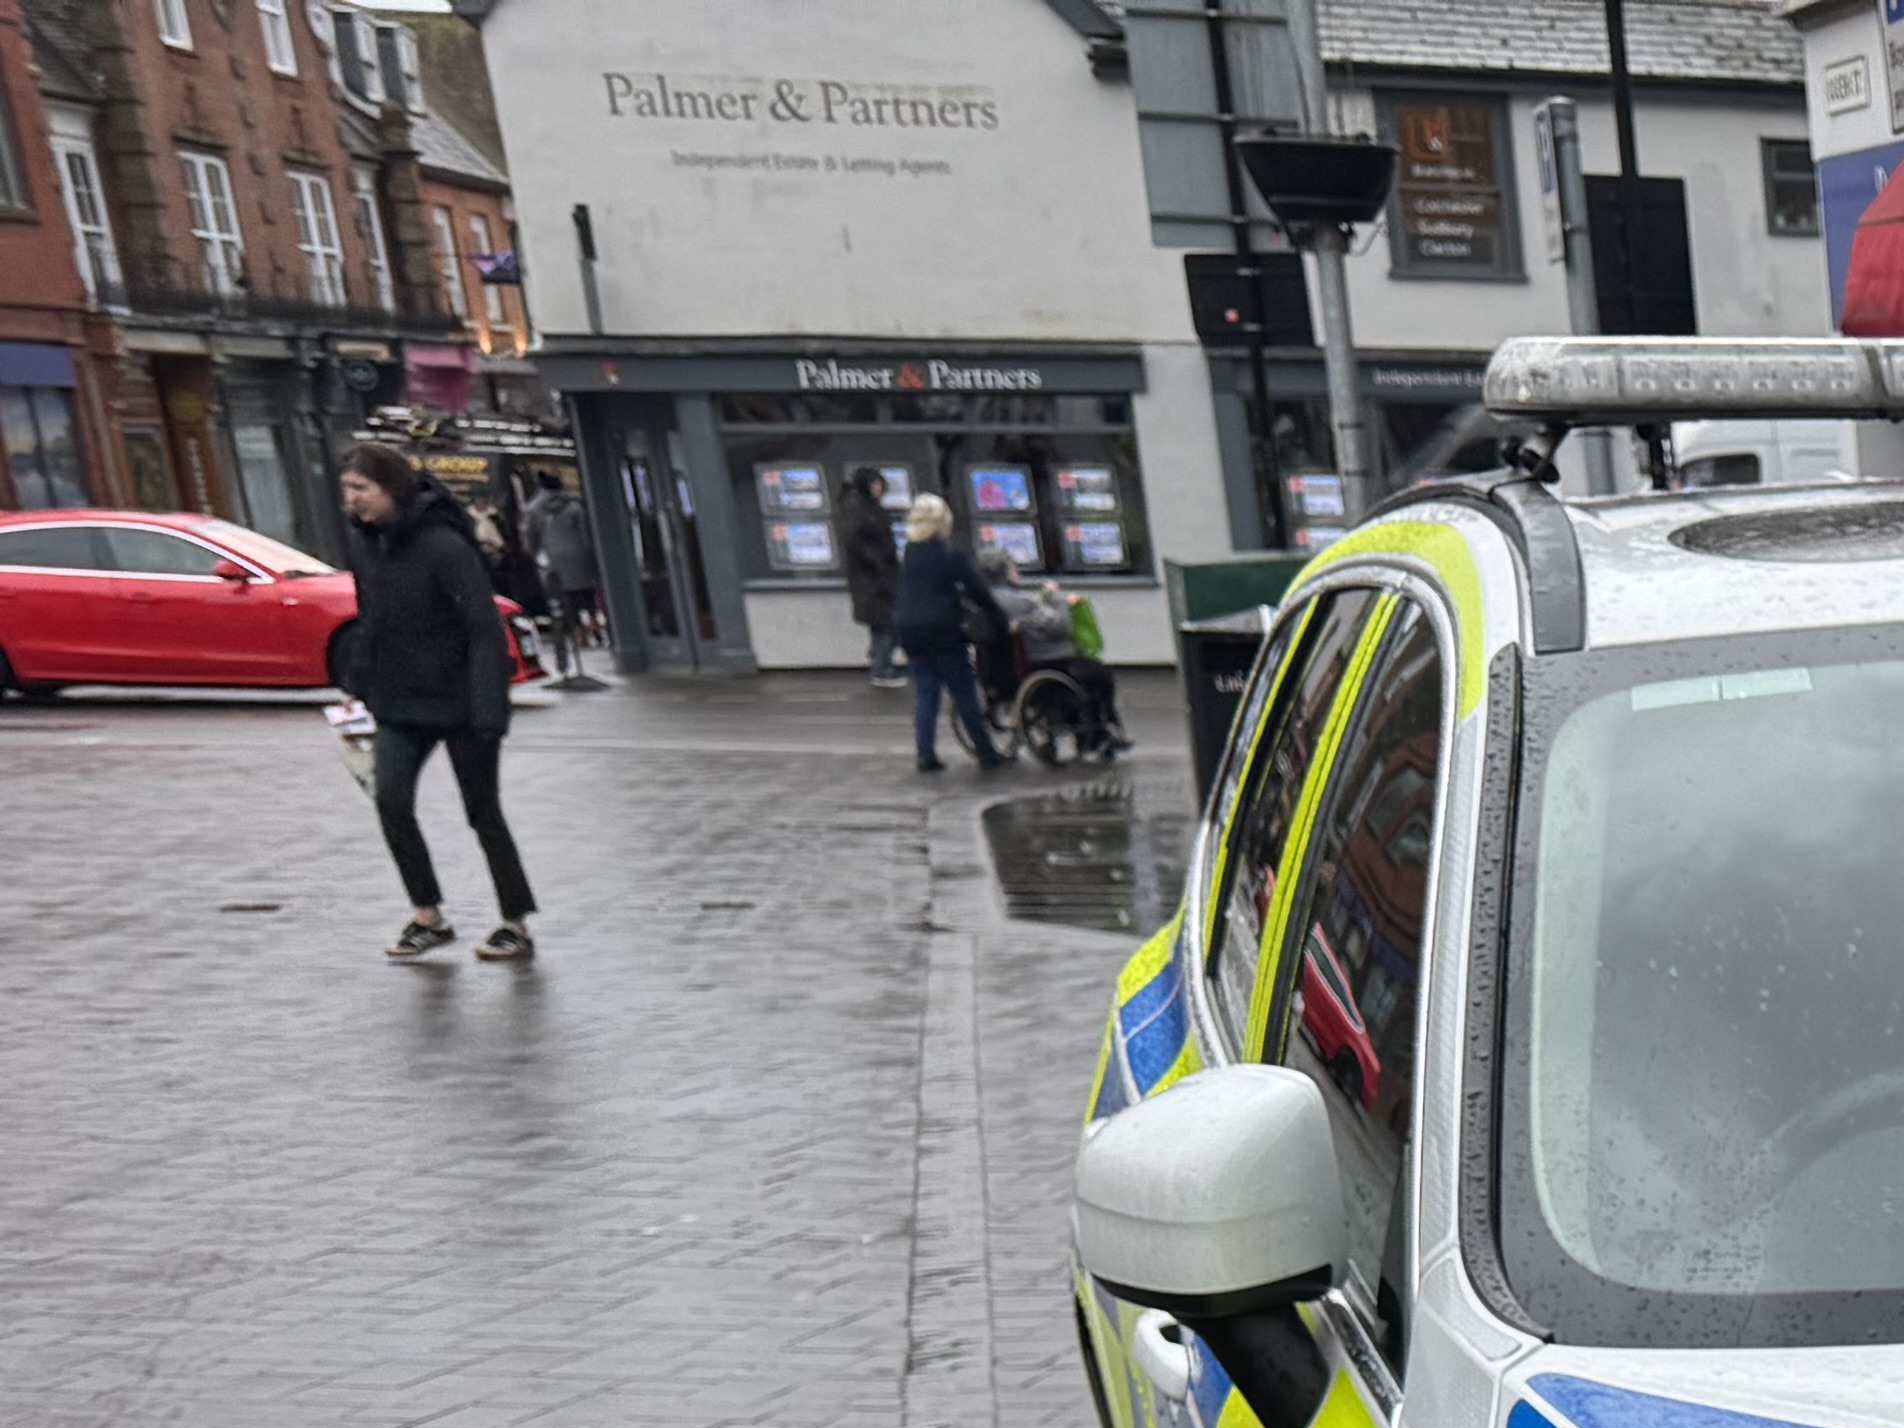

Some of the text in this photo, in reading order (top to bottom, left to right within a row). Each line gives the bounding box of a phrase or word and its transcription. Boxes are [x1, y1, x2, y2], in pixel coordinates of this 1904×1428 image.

[602, 71, 1000, 130] Palmer & Partners
[795, 358, 1042, 390] Palmer & Partners
